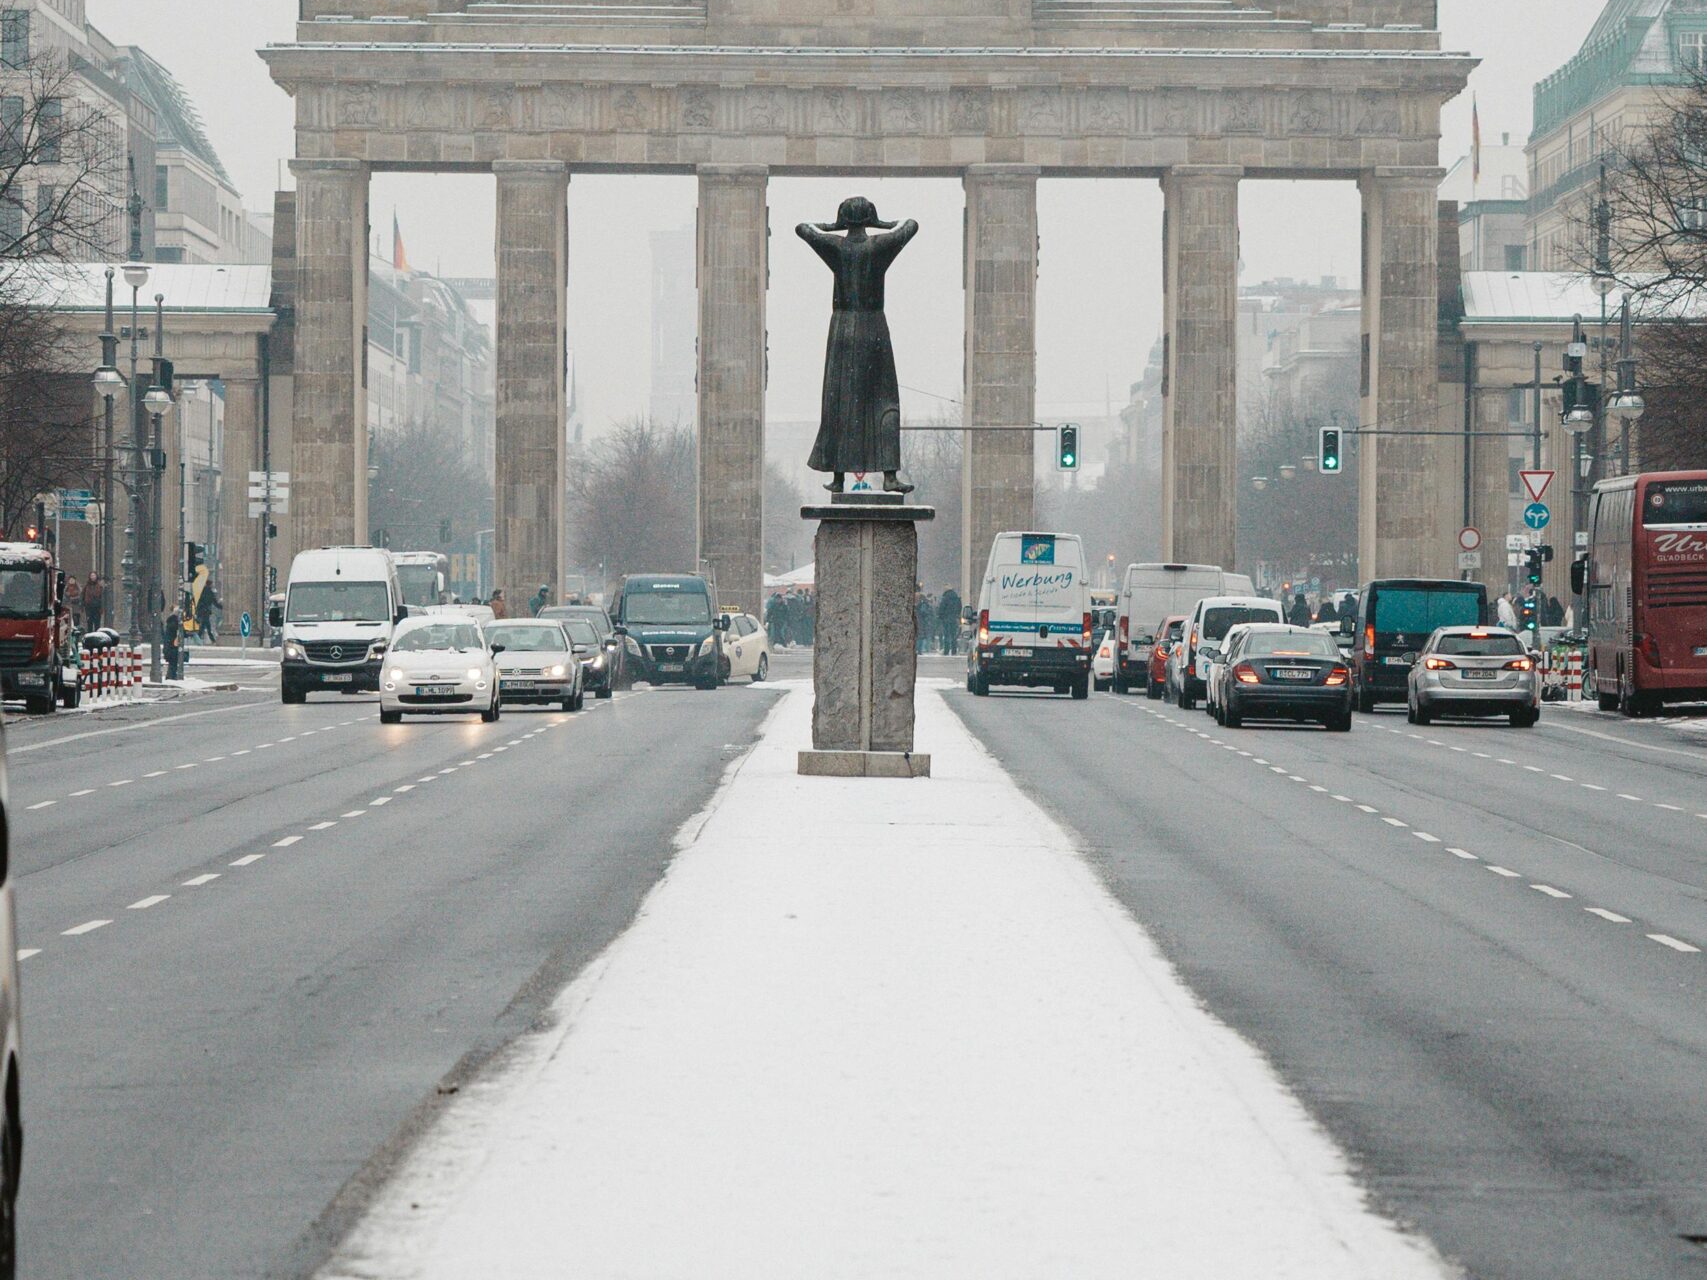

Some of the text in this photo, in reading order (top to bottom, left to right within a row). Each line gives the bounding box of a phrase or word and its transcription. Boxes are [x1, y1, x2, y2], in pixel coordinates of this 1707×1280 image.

[1654, 533, 1707, 552] Ur
[1657, 554, 1704, 562] GLADBECK
[1002, 571, 1073, 590] Werbung
